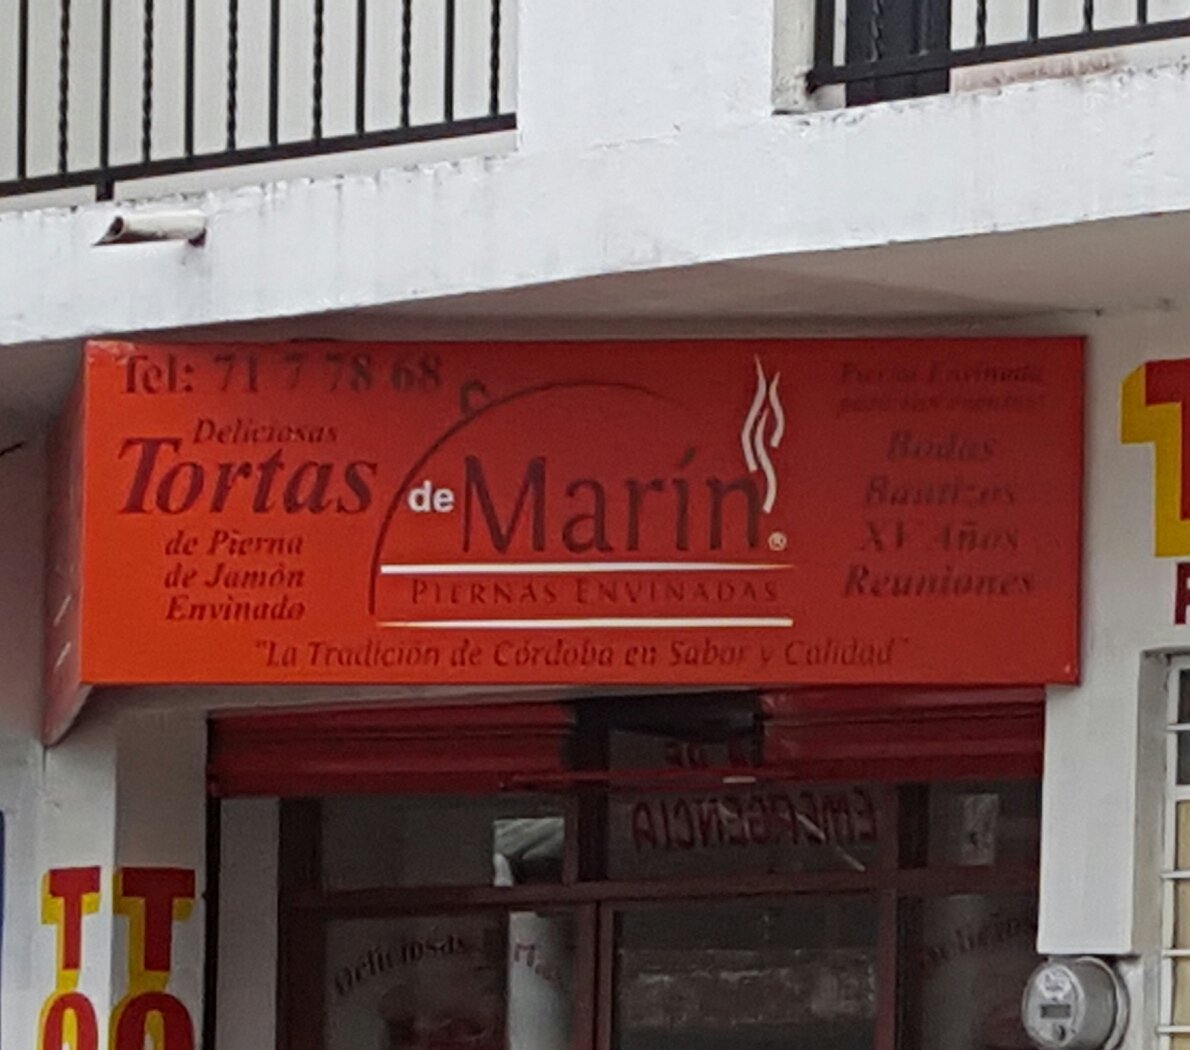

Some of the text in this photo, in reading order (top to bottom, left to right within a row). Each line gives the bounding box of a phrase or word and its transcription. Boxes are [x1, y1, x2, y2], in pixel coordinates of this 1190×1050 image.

[122, 353, 194, 395] Tel:
[213, 351, 259, 394] 71
[324, 351, 374, 393] 78
[193, 417, 338, 444] Deliciosas
[887, 429, 997, 461] Bodas
[117, 436, 378, 516] Tortas
[864, 475, 1016, 507] Bautizos
[408, 446, 761, 553] de Marín
[164, 529, 304, 556] de Pierna
[936, 518, 1020, 552] Años
[163, 562, 306, 589] de Jamón
[411, 577, 778, 605] PIERNAS ENVINADAS
[844, 563, 1036, 597] Reuniones
[164, 595, 306, 622] Envinado
[307, 639, 440, 667] Tradición
[450, 638, 482, 667] de
[493, 637, 615, 667] Córdoba
[624, 648, 657, 666] en
[668, 638, 744, 667] Sabor
